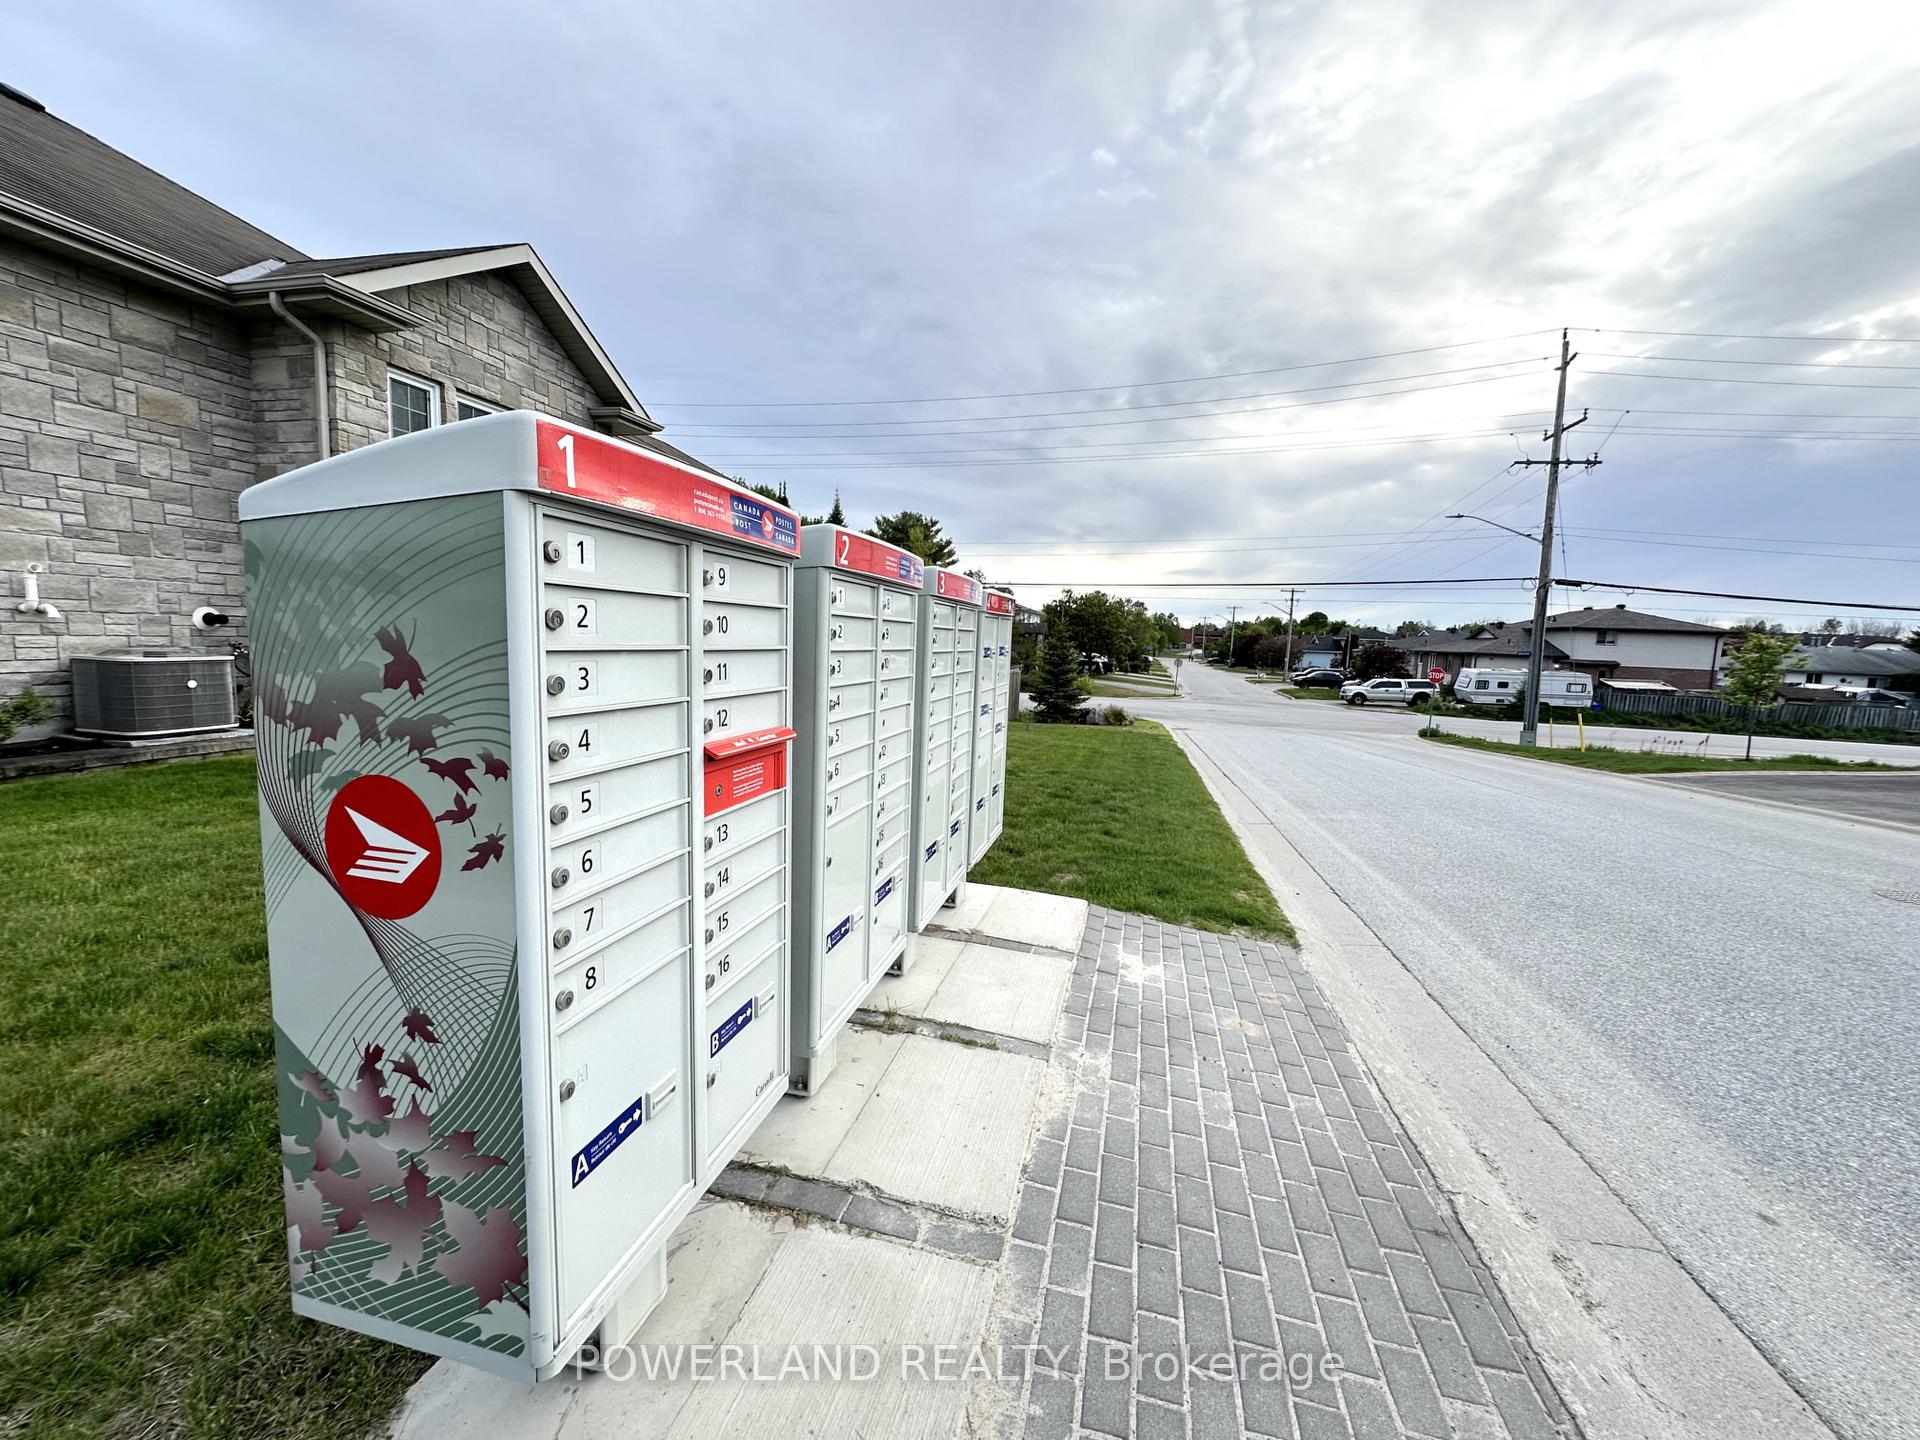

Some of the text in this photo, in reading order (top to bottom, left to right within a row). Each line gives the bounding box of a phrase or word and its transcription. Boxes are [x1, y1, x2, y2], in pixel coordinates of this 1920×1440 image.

[557, 434, 576, 488] 1
[733, 501, 761, 517] CANADA
[734, 519, 752, 531] POST
[775, 516, 793, 530] POSTES
[775, 532, 795, 545] CANADA
[576, 541, 585, 565] 1
[840, 535, 849, 565] 2
[718, 567, 726, 586] 9
[940, 572, 945, 593] 3
[576, 604, 588, 629] 2
[717, 615, 728, 634] 10
[837, 624, 843, 639] 2
[717, 663, 727, 681] 11
[836, 659, 842, 674] 3
[578, 666, 589, 691] 3
[717, 709, 728, 728] 12
[578, 728, 591, 752] 4
[835, 728, 840, 743] 5
[834, 762, 840, 777] 6
[581, 789, 592, 814] 5
[833, 796, 839, 810] 7
[717, 823, 728, 843] 13
[581, 850, 593, 873] 6
[718, 867, 729, 888] 14
[583, 906, 595, 932] 7
[717, 911, 728, 932] 15
[718, 954, 730, 977] 16
[585, 966, 597, 991] 8
[712, 1032, 719, 1055] B
[574, 1153, 589, 1184] A
